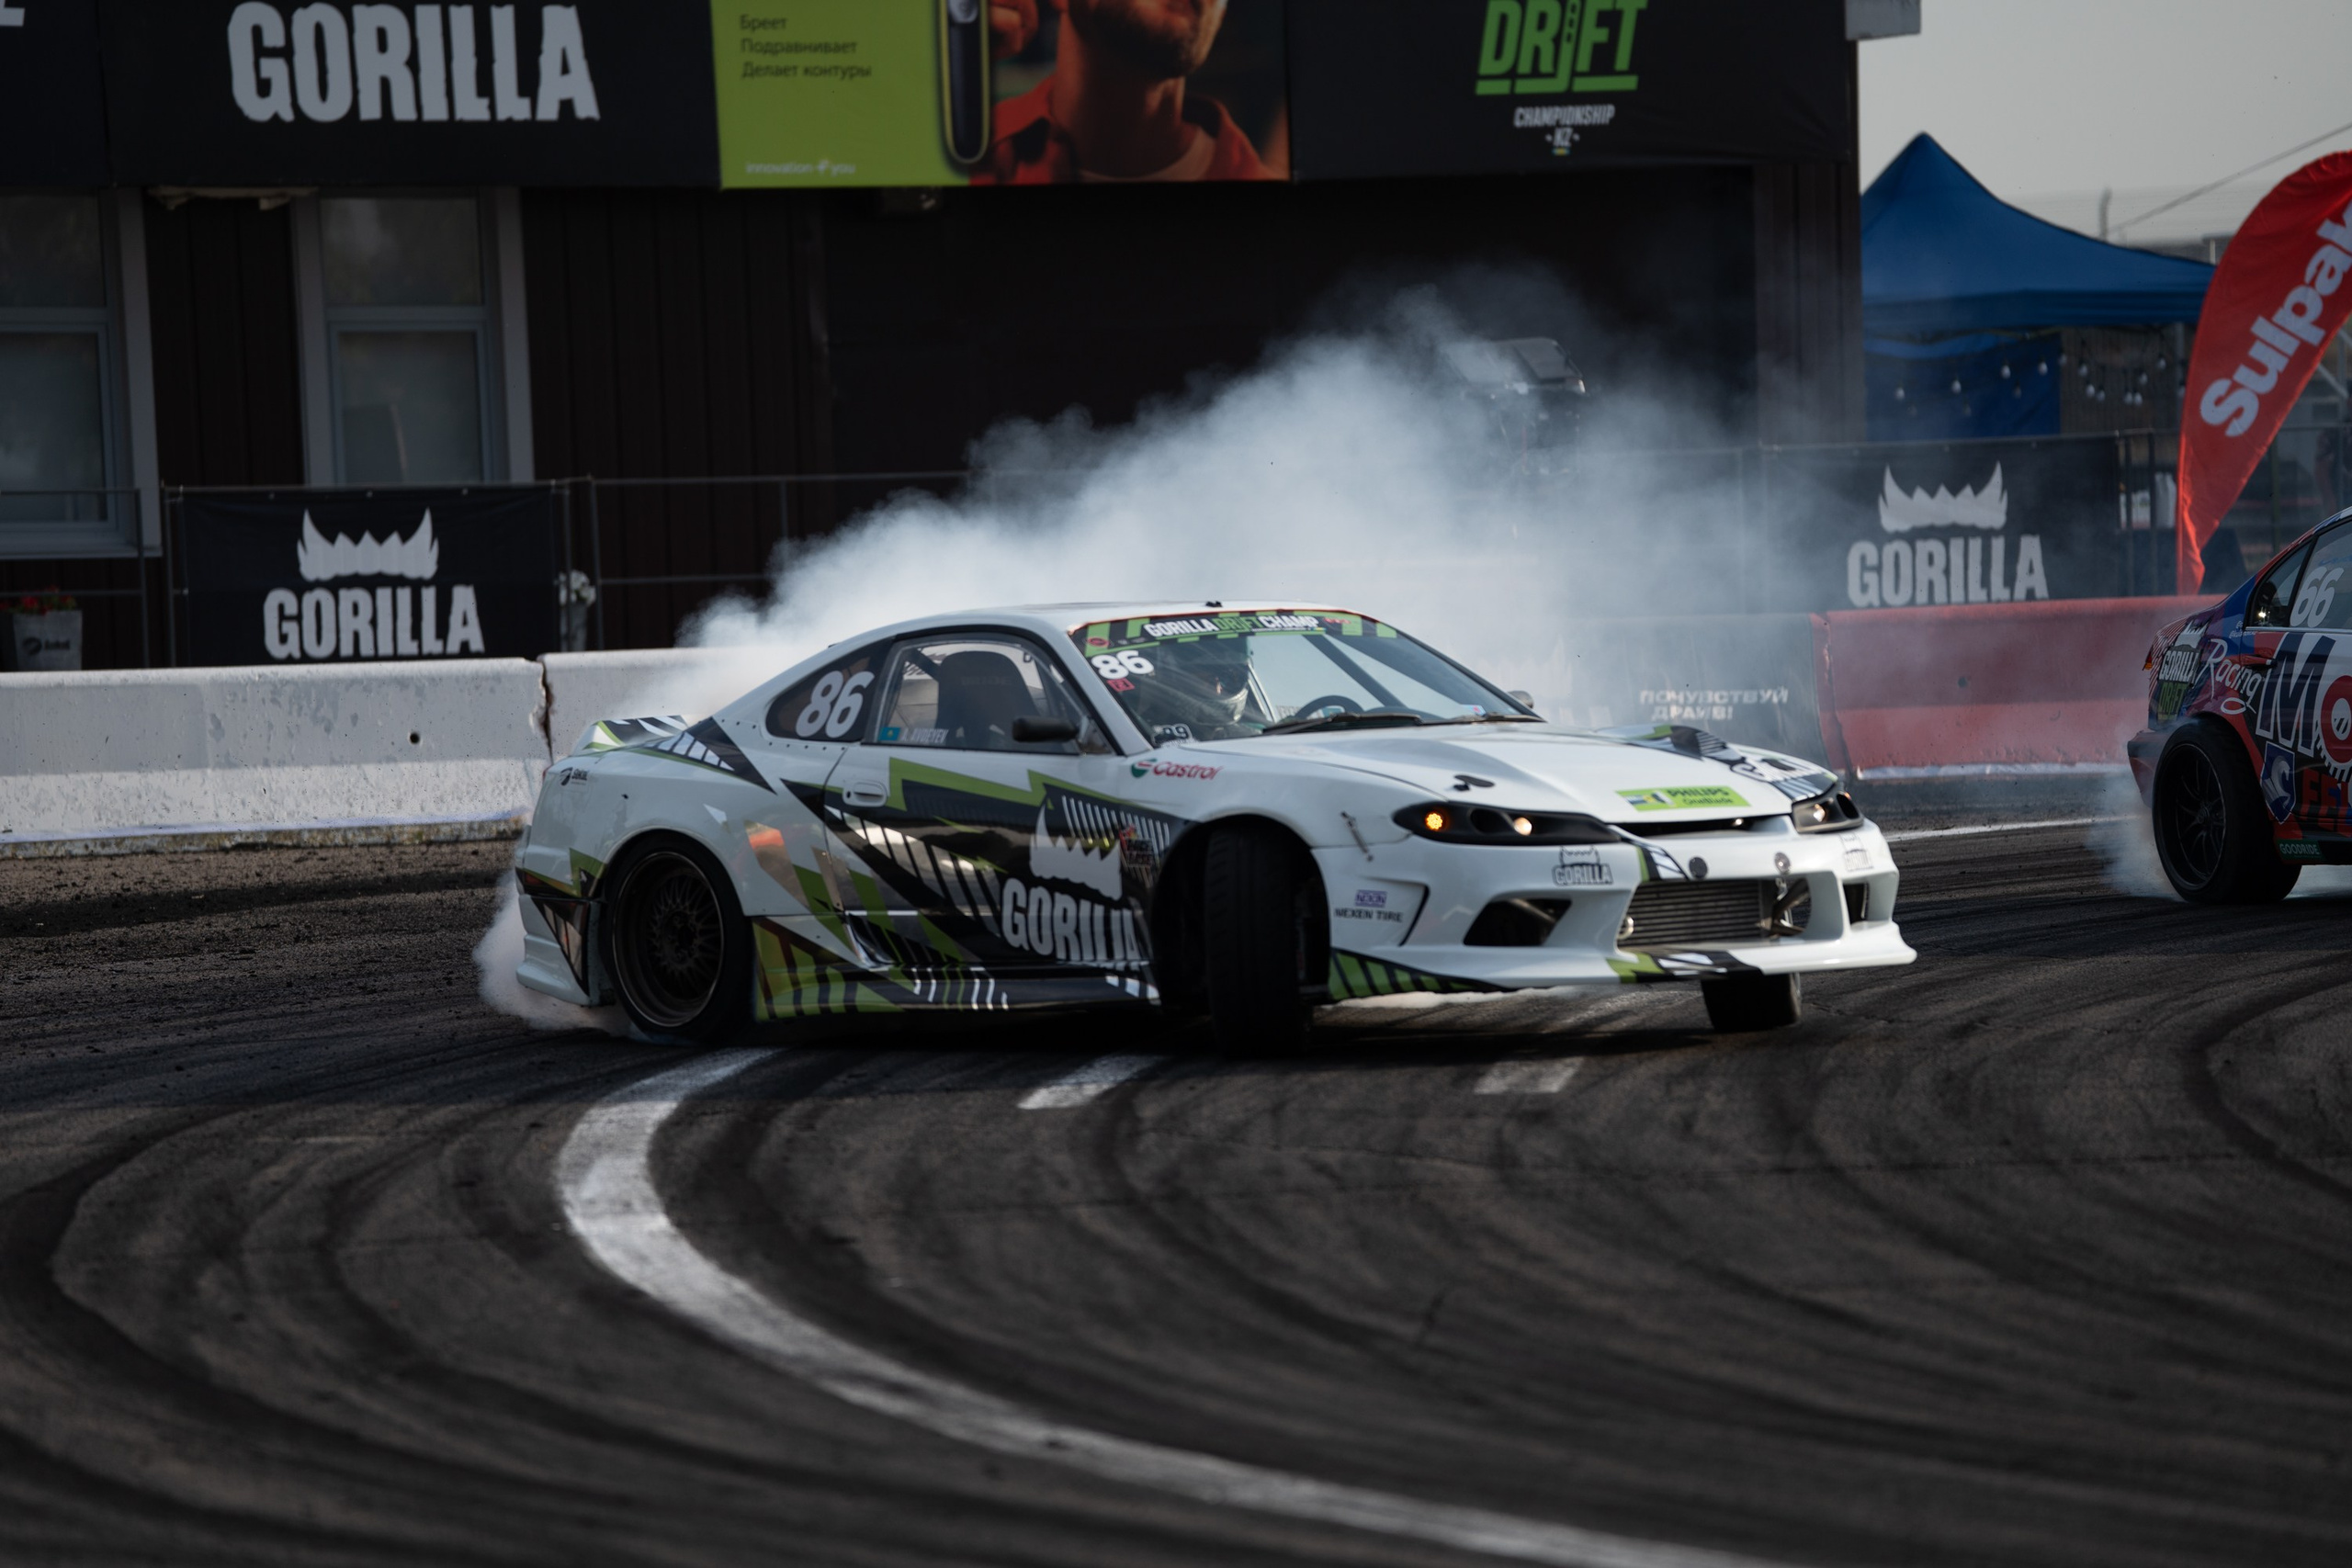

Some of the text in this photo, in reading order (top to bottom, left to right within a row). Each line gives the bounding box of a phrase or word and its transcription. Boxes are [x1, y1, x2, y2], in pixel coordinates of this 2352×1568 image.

[740, 14, 787, 31] Бреет
[741, 38, 858, 56] Подравнивает
[1476, 0, 1648, 93] DRIFT
[227, 2, 600, 122] GORILLA
[741, 62, 873, 80] Делает контуры
[1513, 104, 1616, 127] CHAMPIONSHIP
[745, 162, 812, 175] innovation
[831, 162, 856, 176] you
[1847, 535, 2049, 608] GORILLA
[2290, 566, 2345, 628] 66
[263, 585, 485, 660] GORILLA
[1144, 618, 1219, 637] GORILLA
[1212, 615, 1263, 634] DRIFT
[1257, 615, 1320, 630] CHAMP
[1091, 649, 1155, 680] 86
[2159, 649, 2200, 682] GORILLA
[2192, 637, 2263, 715] Racing
[795, 670, 876, 739] 86
[1639, 686, 1790, 705] ПОЧУВСТВУЙ
[1152, 761, 1224, 781] Castrol
[2279, 842, 2321, 856] GOODRIDE
[1553, 863, 1613, 886] GORILLA
[1002, 877, 1143, 966] GORILLA
[1335, 908, 1405, 922] NEXEN TIRE
